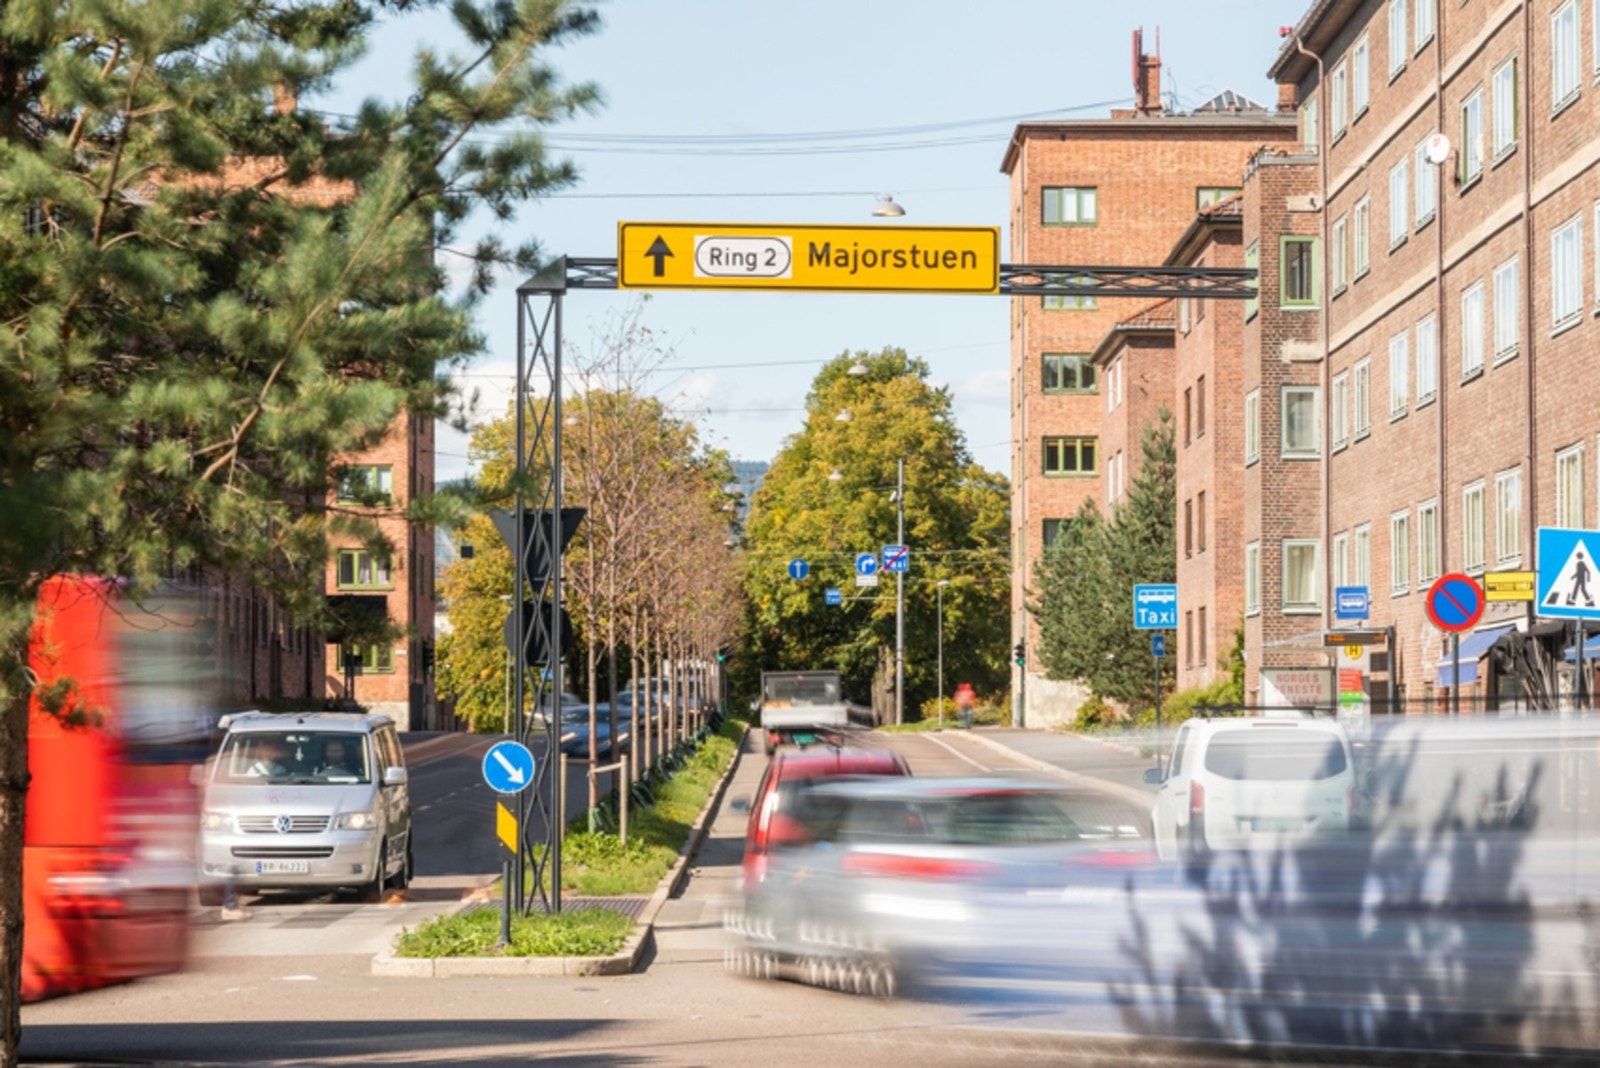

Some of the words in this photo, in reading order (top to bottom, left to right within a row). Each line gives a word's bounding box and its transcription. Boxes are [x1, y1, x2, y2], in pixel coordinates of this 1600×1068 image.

[709, 247, 757, 272] Ring
[763, 247, 777, 266] 2
[808, 241, 977, 275] Majorstuen
[1138, 607, 1175, 624] Taxi
